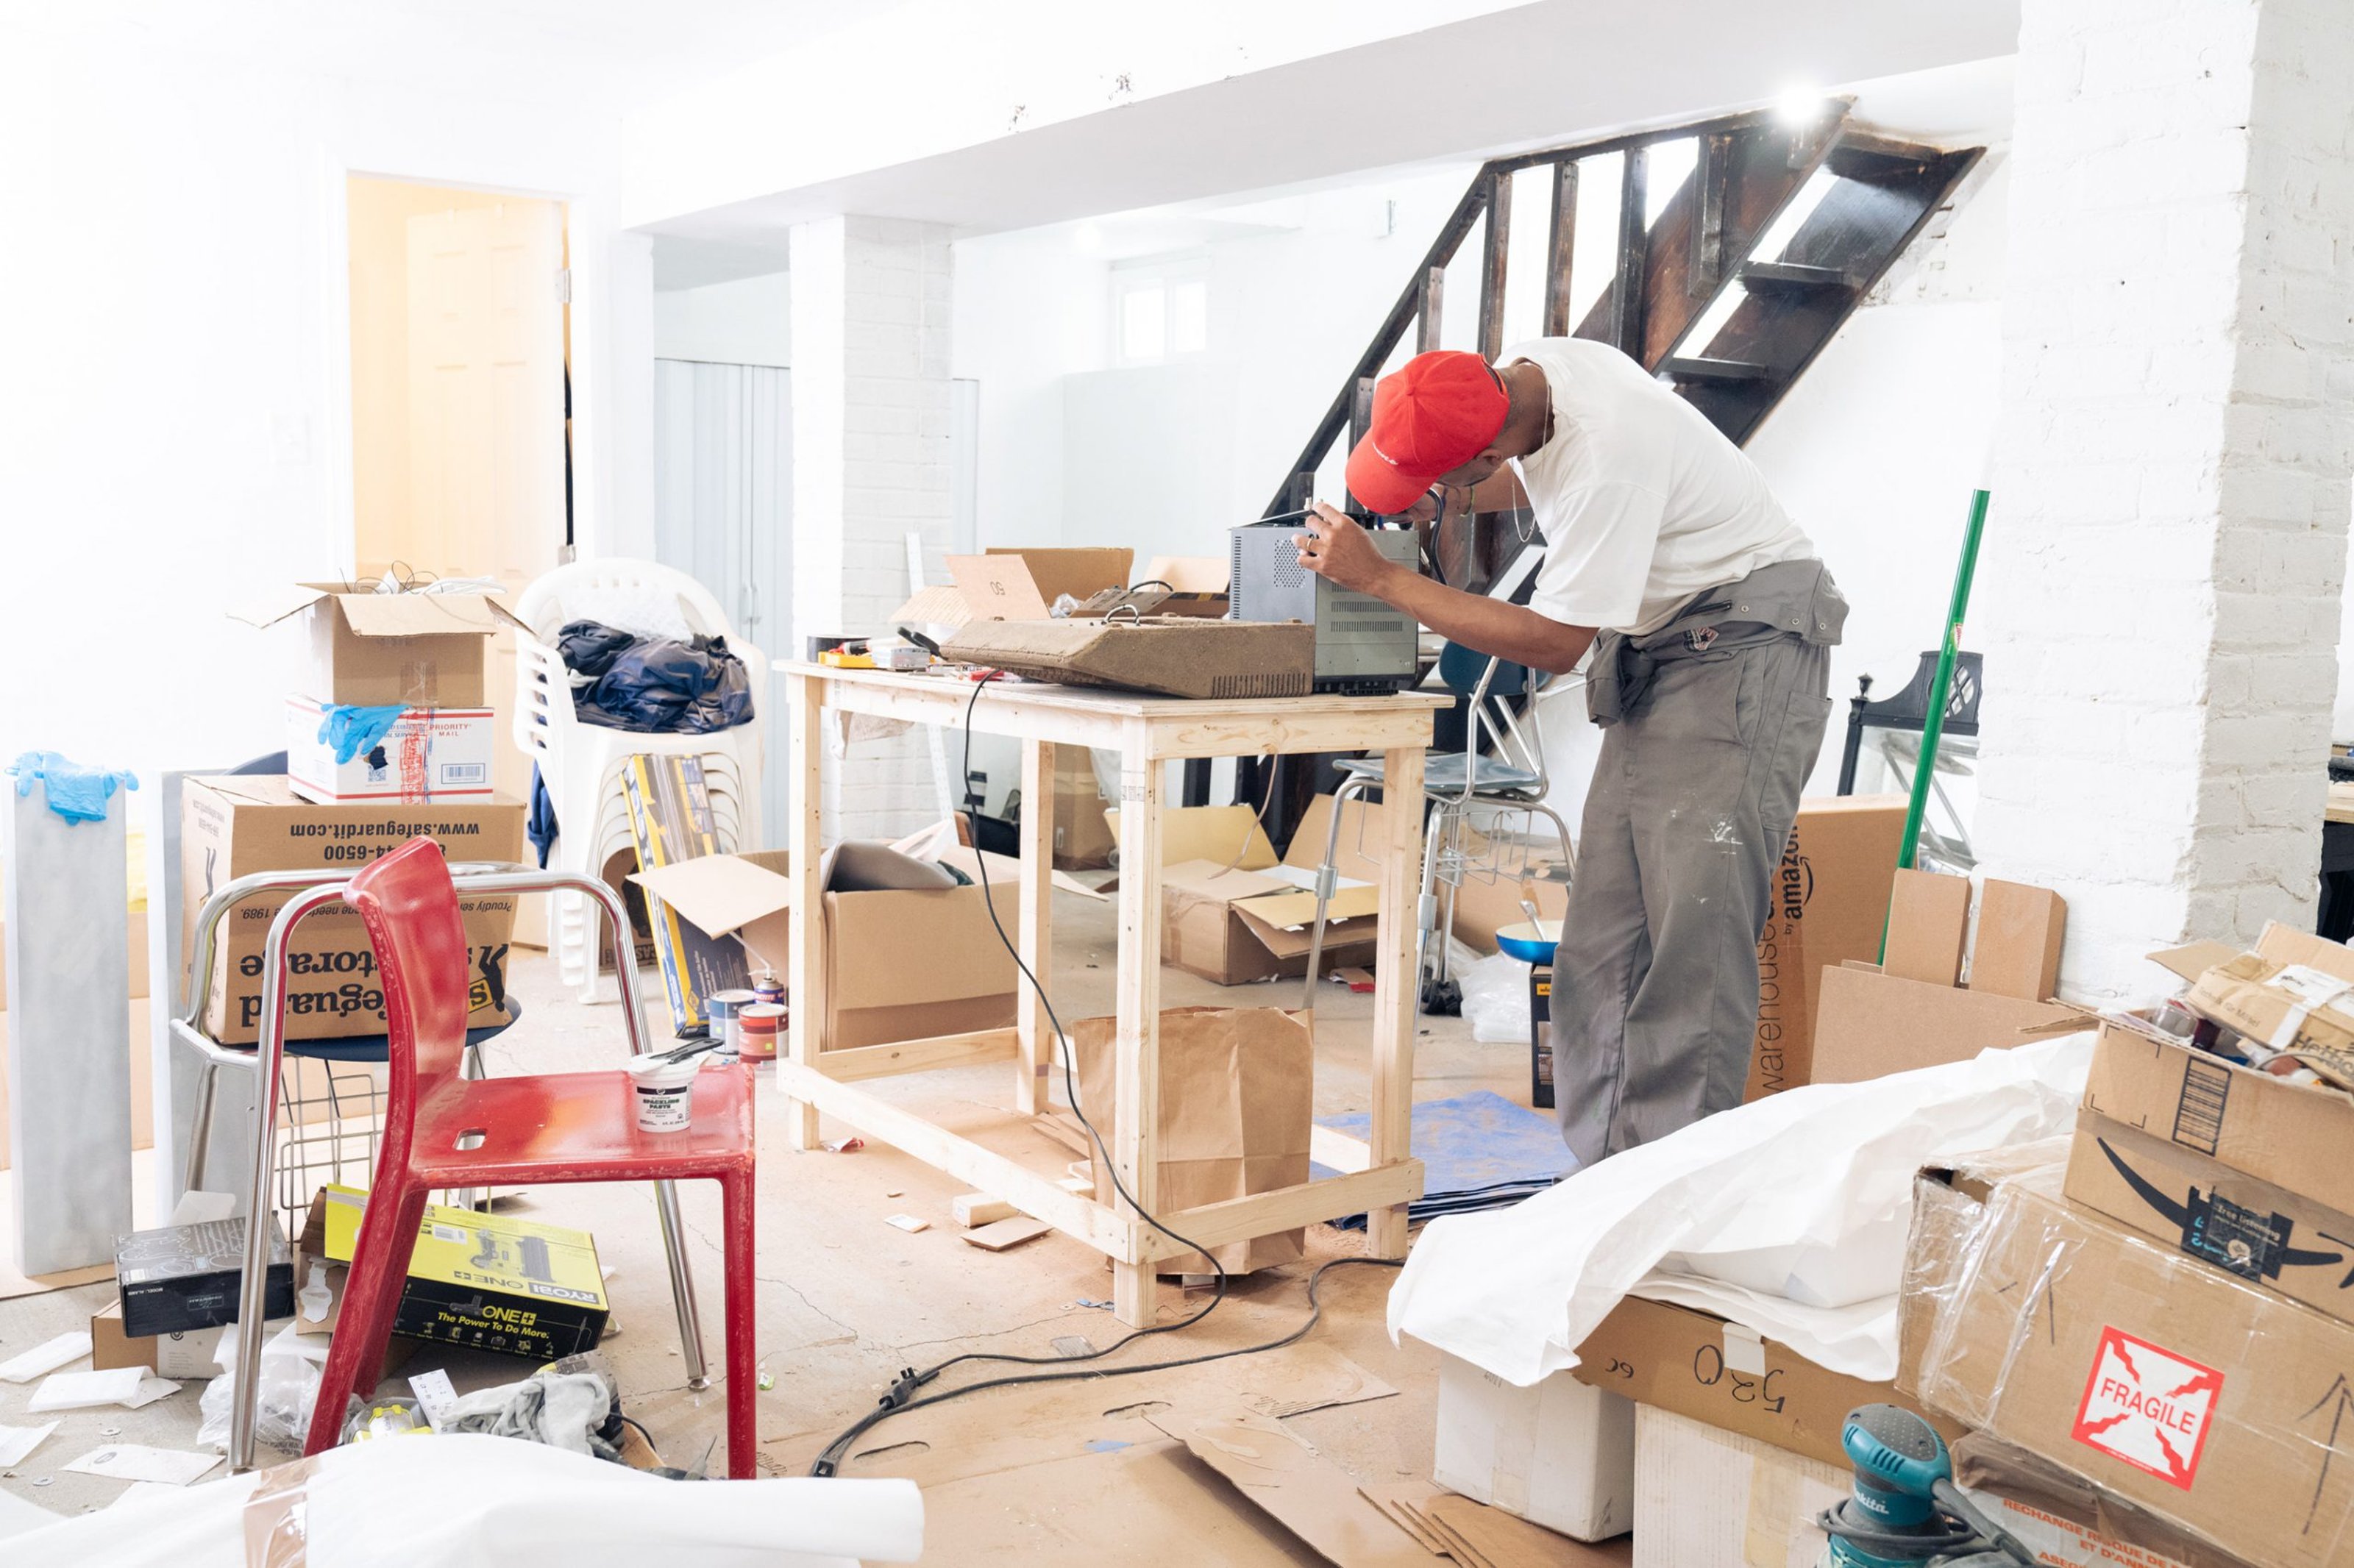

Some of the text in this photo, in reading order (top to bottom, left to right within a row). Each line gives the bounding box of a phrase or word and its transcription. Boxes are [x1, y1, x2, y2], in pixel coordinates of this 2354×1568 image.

[290, 821, 480, 839] www.safeguardit.com
[241, 908, 270, 919] 1989.
[477, 901, 512, 912] Proudly
[1785, 923, 1793, 935] by
[240, 949, 379, 978] torae
[533, 1283, 597, 1303] RYOBI
[438, 1311, 456, 1323] The
[458, 1316, 488, 1329] Power
[492, 1322, 502, 1330] To
[505, 1325, 519, 1335] Do
[2100, 1377, 2196, 1435] FRAGILE
[2002, 1498, 2083, 1536] RECHANGE
[2146, 1553, 2167, 1567] DE
[2080, 1539, 2097, 1553] ET
